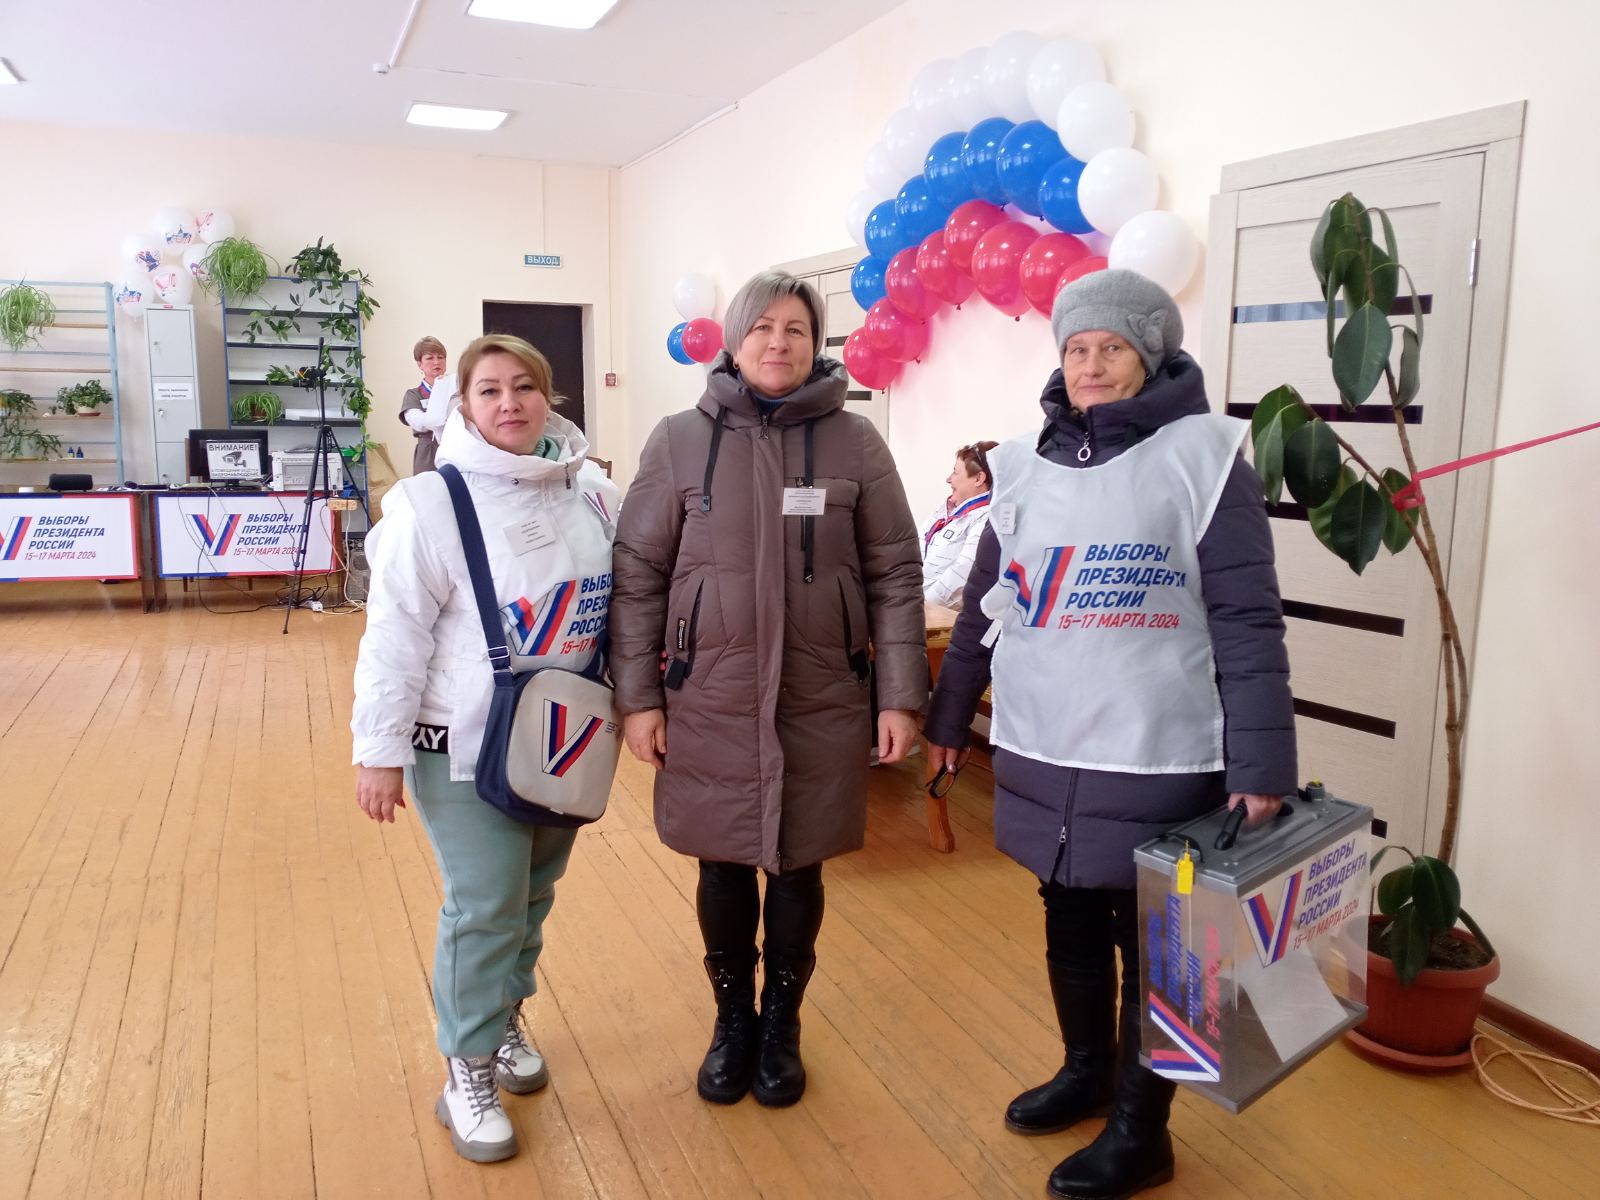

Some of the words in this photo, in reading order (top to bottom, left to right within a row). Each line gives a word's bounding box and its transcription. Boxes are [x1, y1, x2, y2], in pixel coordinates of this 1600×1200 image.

[527, 256, 558, 265] ВЫХОД
[38, 515, 90, 526] ВЫБОРЫ
[246, 513, 293, 522] ВЫБОРЫ
[33, 527, 105, 538] ПРЕЗИДЕНТА
[28, 540, 75, 550] РОССИИ
[237, 536, 280, 546] РОССИИ
[47, 551, 76, 560] МАРТА
[76, 551, 97, 559] 2024
[254, 547, 281, 555] МАРТА
[1083, 543, 1171, 562] ВЫБОРЫ
[1074, 566, 1187, 587] ПРЕЗИДЕНТА
[581, 573, 612, 594] ВЫБО
[1064, 591, 1147, 609] РОССИИ
[1096, 613, 1147, 628] МАРТА
[1147, 613, 1180, 628] 2024
[1308, 839, 1356, 881] ВЫБОРЫ
[1303, 852, 1368, 906] ПРЕЗИДЕНТА
[1297, 890, 1342, 929] РОССИИ
